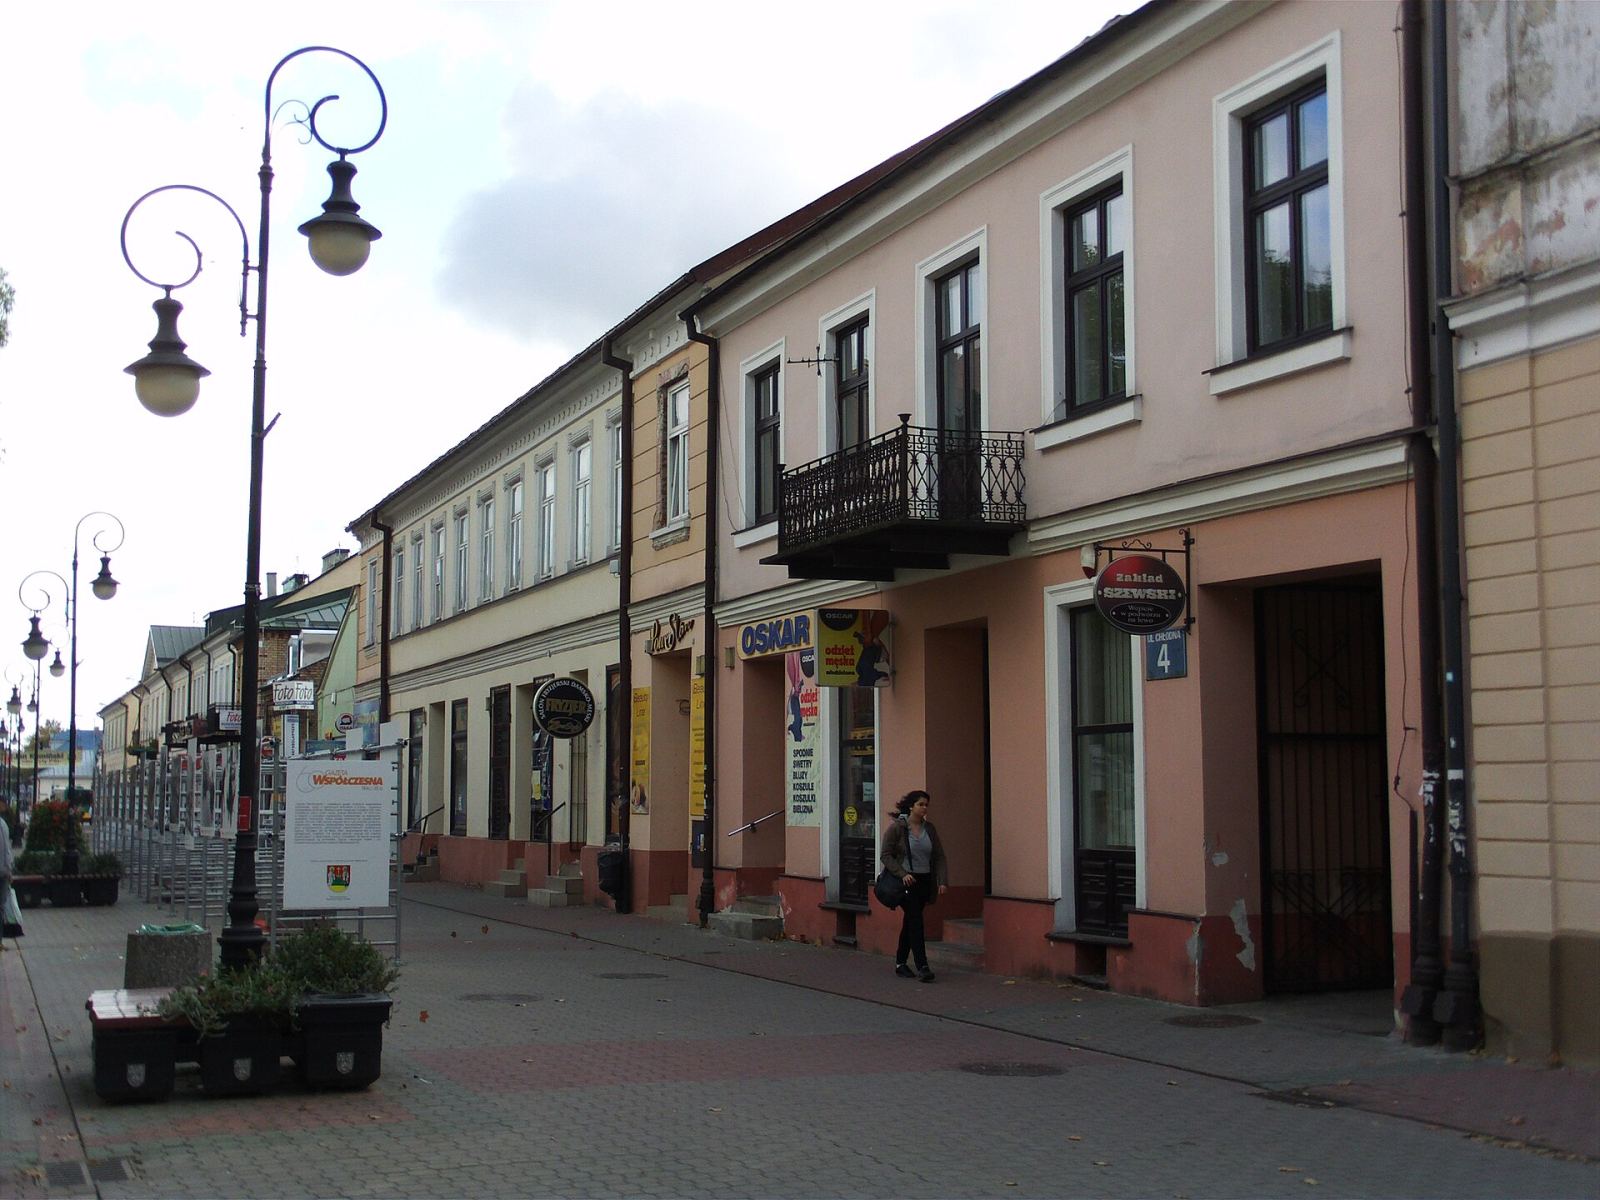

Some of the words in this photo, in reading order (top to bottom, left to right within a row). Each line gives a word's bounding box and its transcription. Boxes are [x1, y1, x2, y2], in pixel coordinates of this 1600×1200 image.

[1103, 587, 1177, 600] SZEWSKI
[741, 614, 810, 656] OSKAR
[826, 656, 855, 669] męska
[1157, 643, 1170, 673] 4
[275, 683, 295, 700] Foto
[295, 682, 313, 699] Foto
[793, 748, 814, 758] SPODNIE
[793, 760, 812, 769] SWETRY
[313, 774, 384, 786] WSPÓŁCZESNA
[793, 771, 808, 780] BLUZY
[793, 782, 815, 791] KOSZULE
[793, 794, 816, 803] KOSZULKI
[793, 805, 813, 814] BIELIZNA
